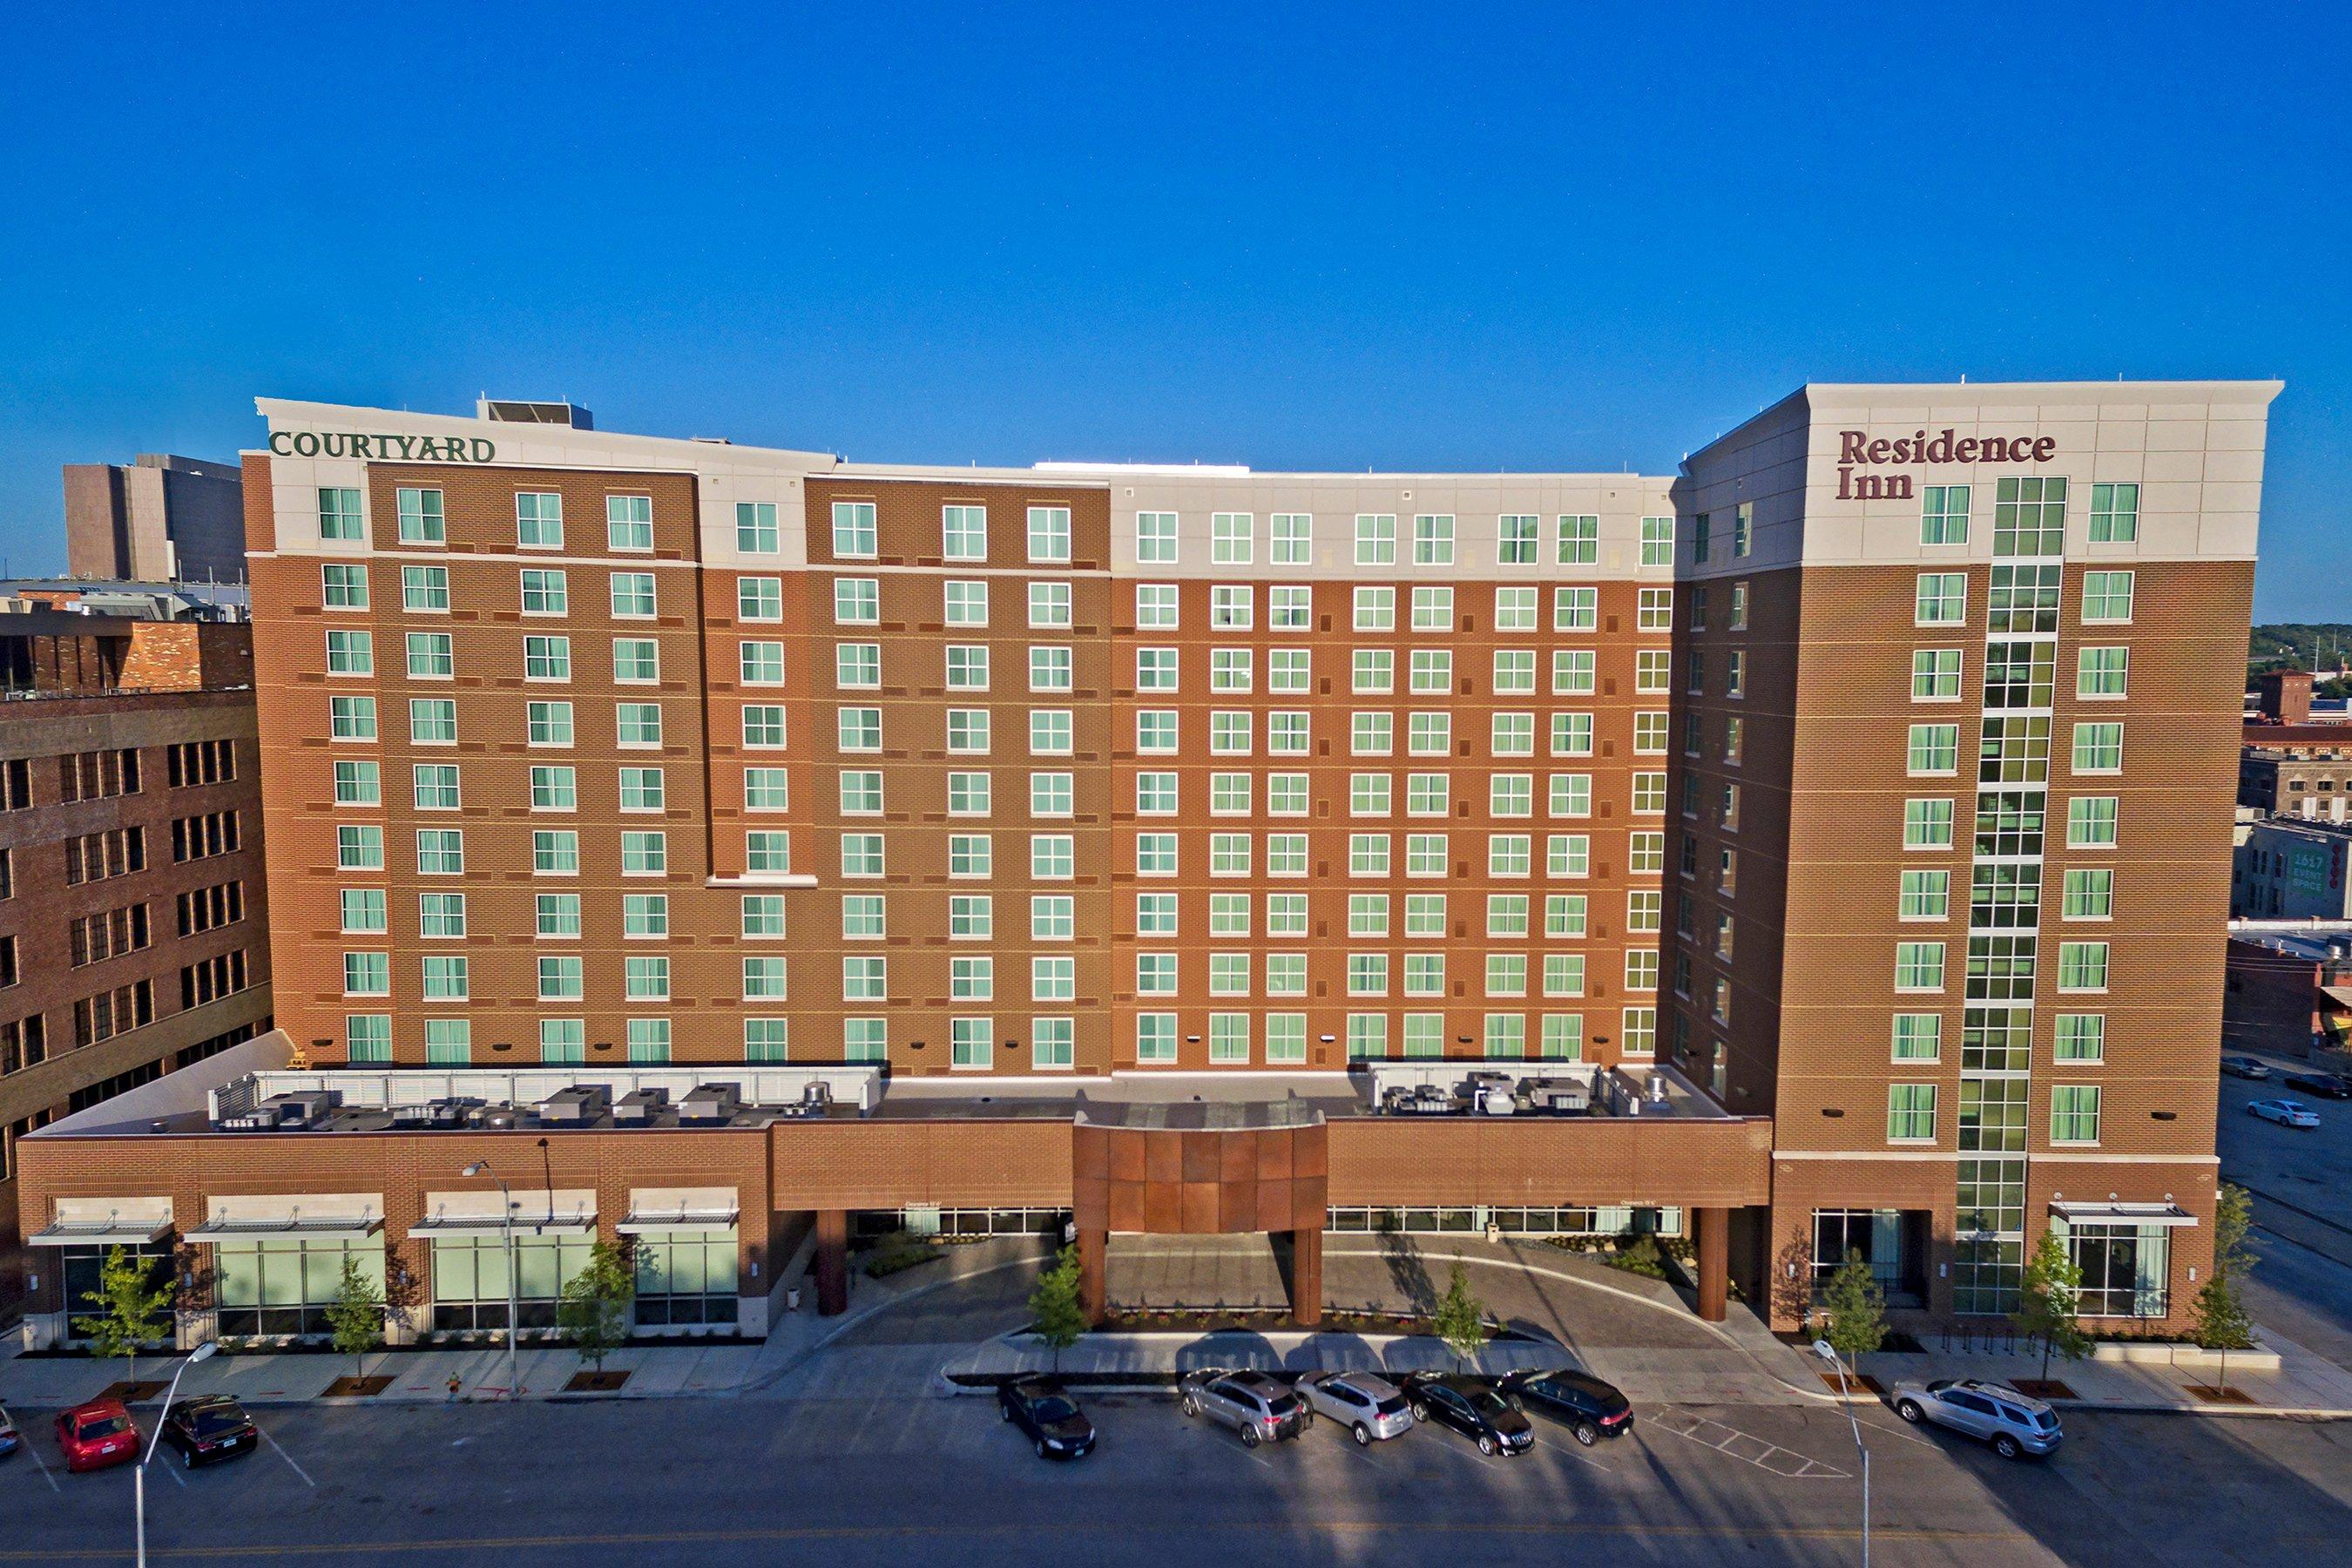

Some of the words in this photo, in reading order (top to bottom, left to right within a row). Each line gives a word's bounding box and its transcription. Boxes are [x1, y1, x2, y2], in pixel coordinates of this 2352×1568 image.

[269, 431, 496, 463] COURTYARD
[1837, 429, 2056, 463] Residence
[1835, 467, 1914, 499] Inn
[2293, 878, 2322, 891] SPACE
[2294, 868, 2322, 880] EVENT
